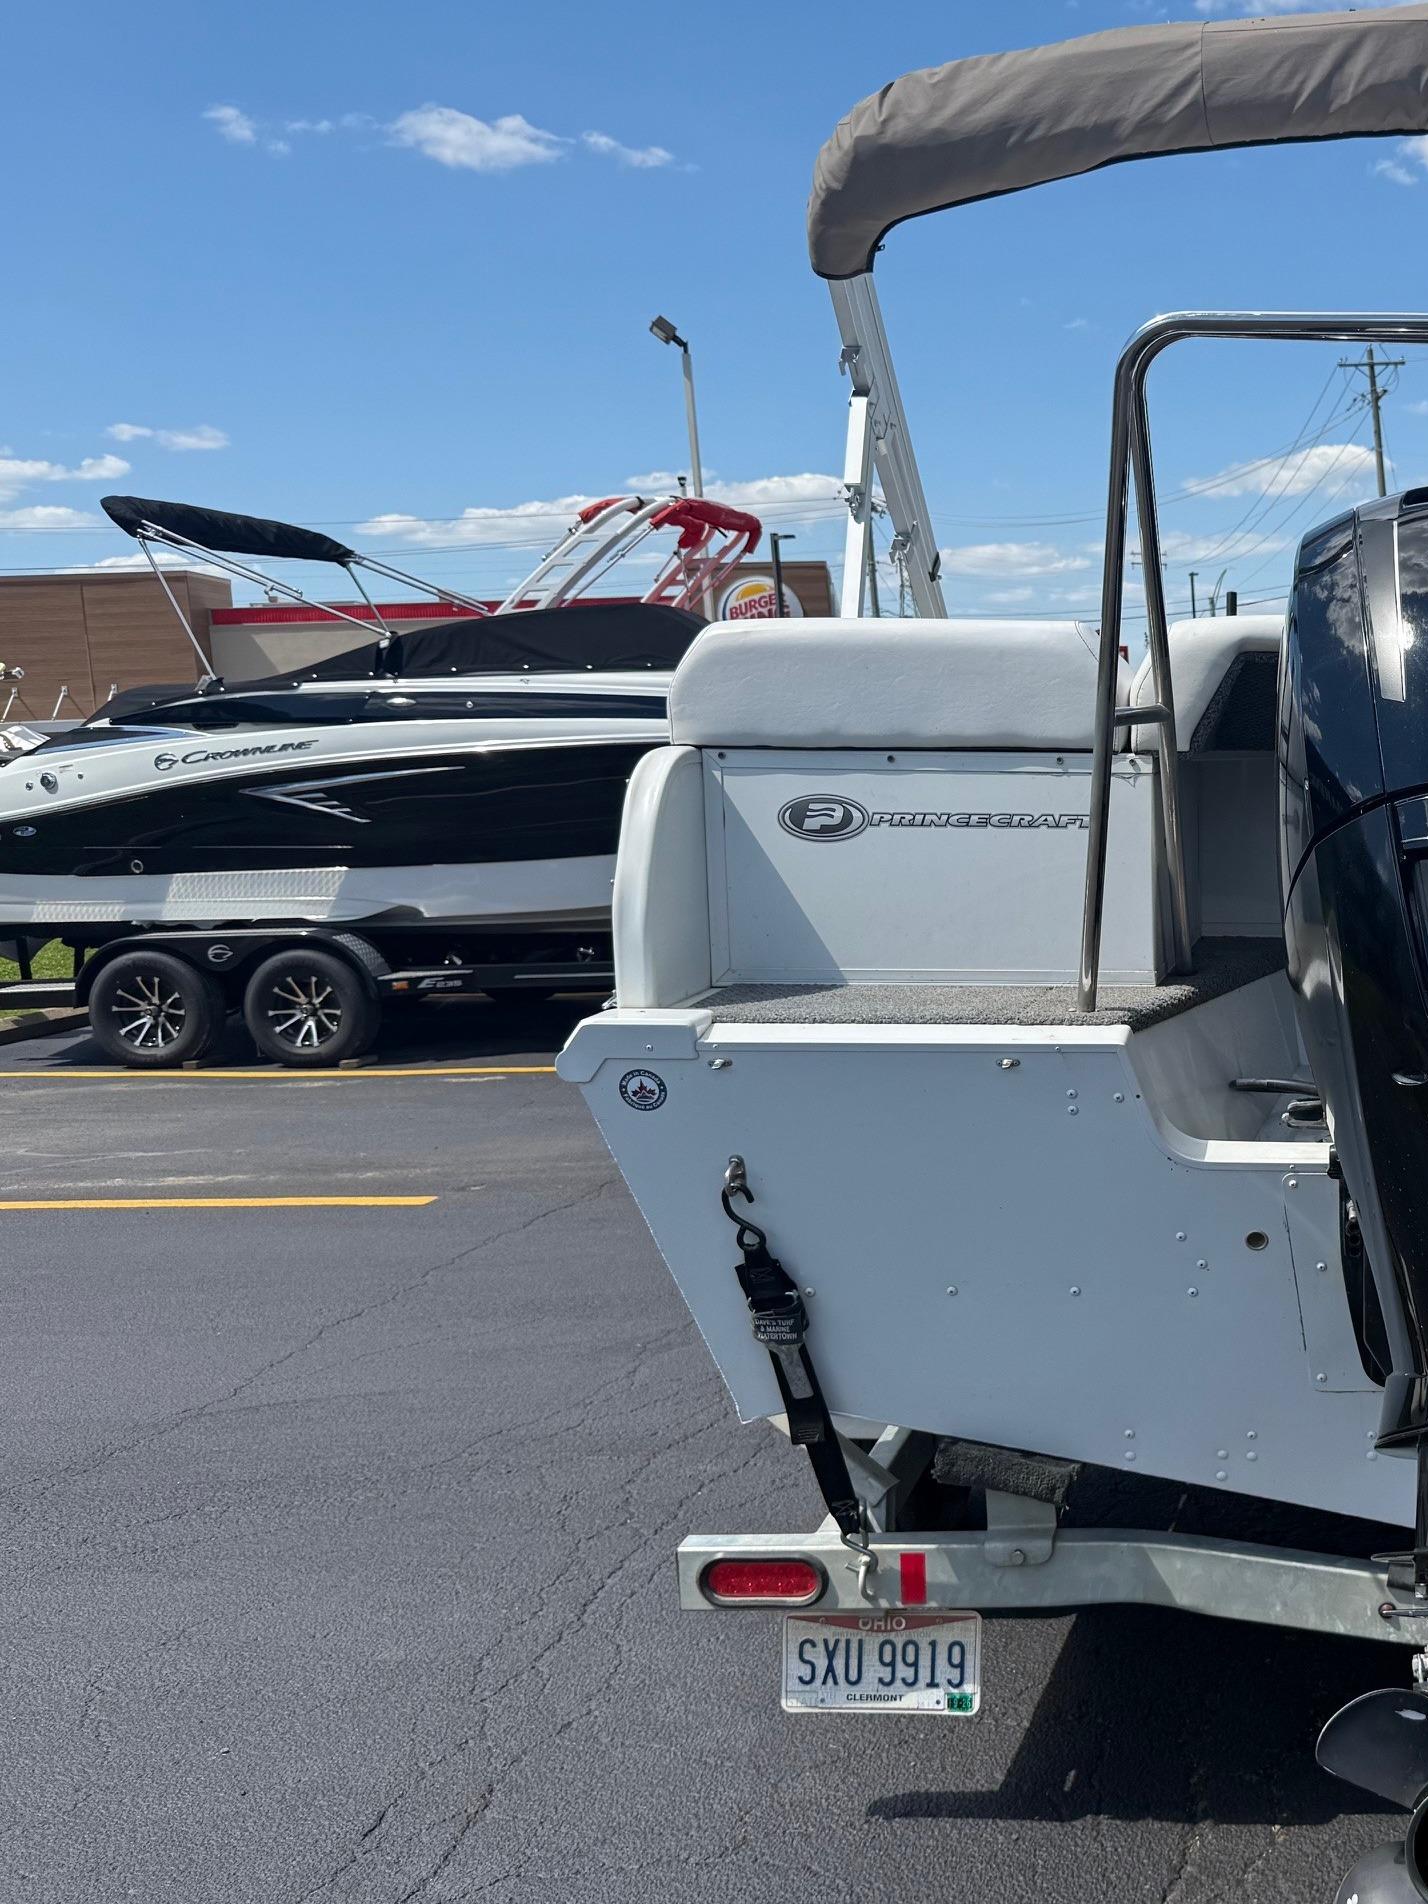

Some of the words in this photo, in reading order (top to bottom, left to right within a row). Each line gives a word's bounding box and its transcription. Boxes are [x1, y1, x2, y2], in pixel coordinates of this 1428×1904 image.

[729, 592, 787, 620] BURGE
[181, 739, 320, 765] CROWNLINE
[869, 811, 1090, 829] PRINCECRAFT
[858, 1616, 907, 1631] OHIO
[797, 1638, 864, 1686] SXU
[877, 1639, 966, 1689] 9919
[846, 1693, 905, 1702] CLERMONT
